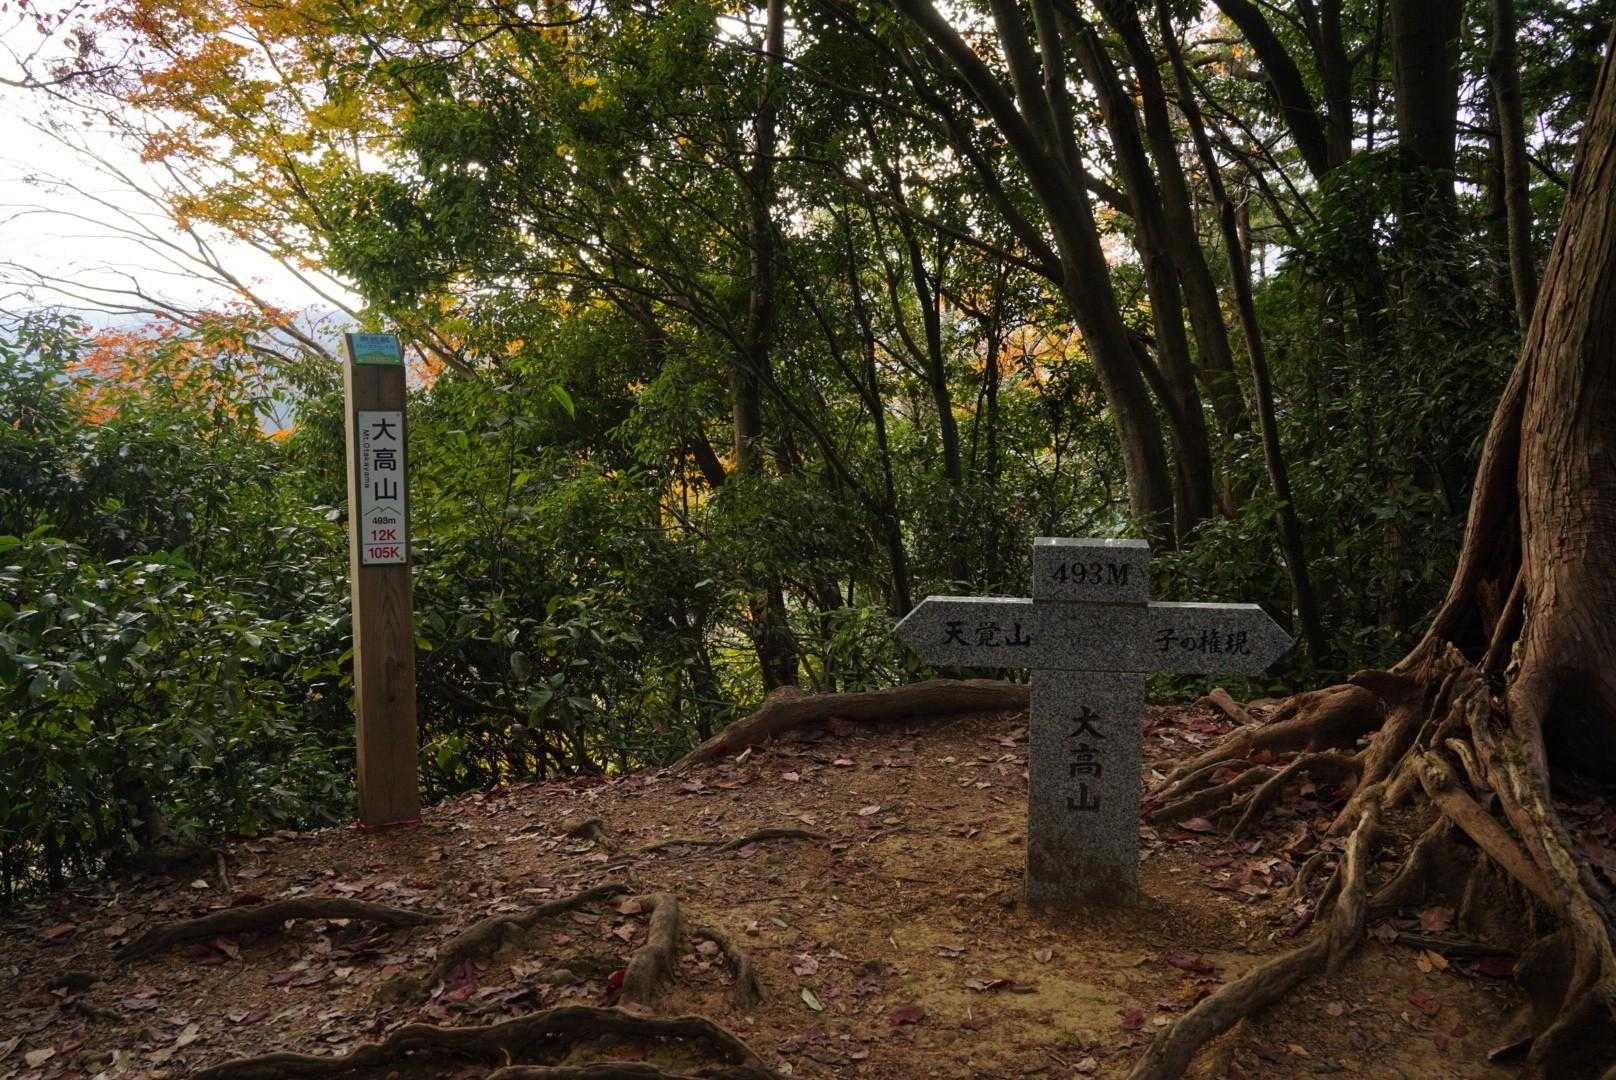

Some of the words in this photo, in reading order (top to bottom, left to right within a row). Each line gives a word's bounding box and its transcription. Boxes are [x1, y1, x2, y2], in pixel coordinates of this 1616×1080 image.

[372, 418, 397, 501] 大高山
[371, 529, 397, 541] 12K
[368, 546, 400, 559] 105K
[1051, 562, 1130, 585] 493M
[942, 621, 1031, 648] 天覚山
[1154, 628, 1251, 656] 子の権現
[1064, 704, 1108, 813] 大高山
